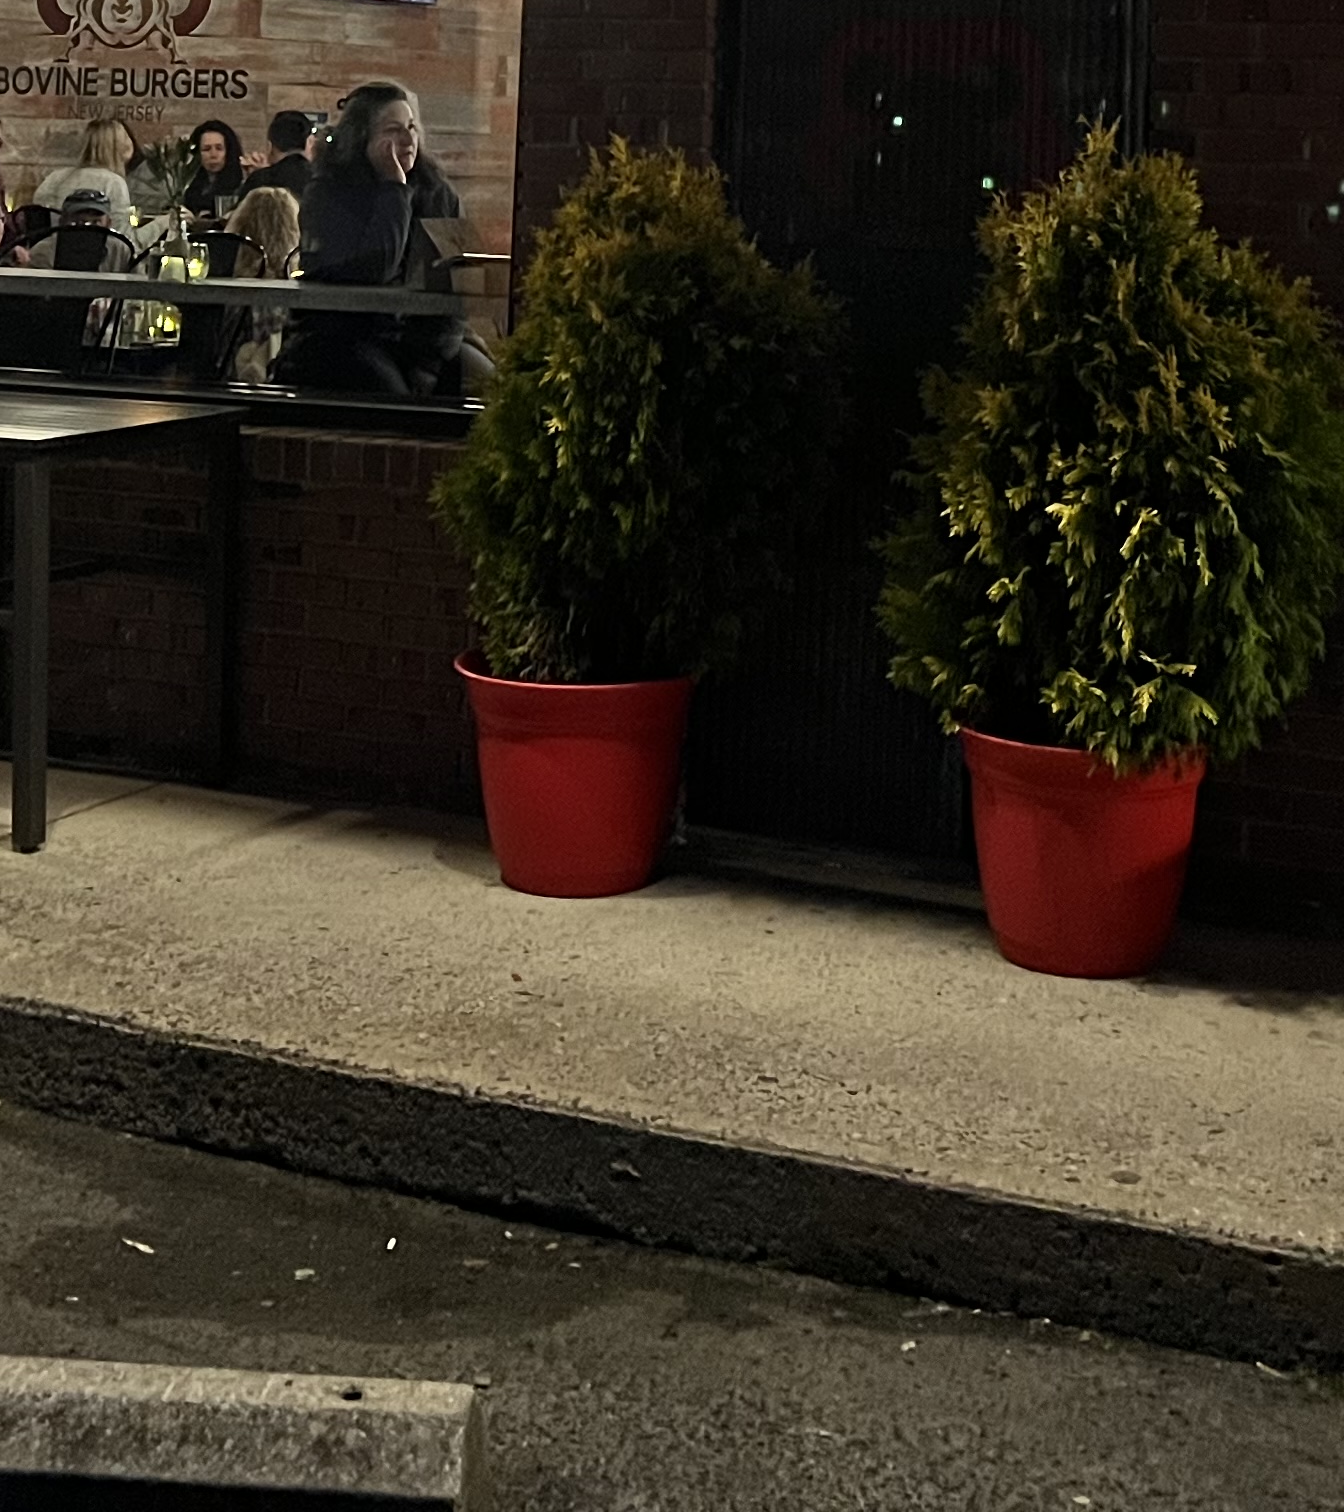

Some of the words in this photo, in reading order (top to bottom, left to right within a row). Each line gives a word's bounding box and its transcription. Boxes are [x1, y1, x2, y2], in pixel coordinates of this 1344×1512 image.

[109, 68, 249, 100] BURGERS
[67, 104, 105, 120] NEW
[112, 104, 165, 122] JERSEY
